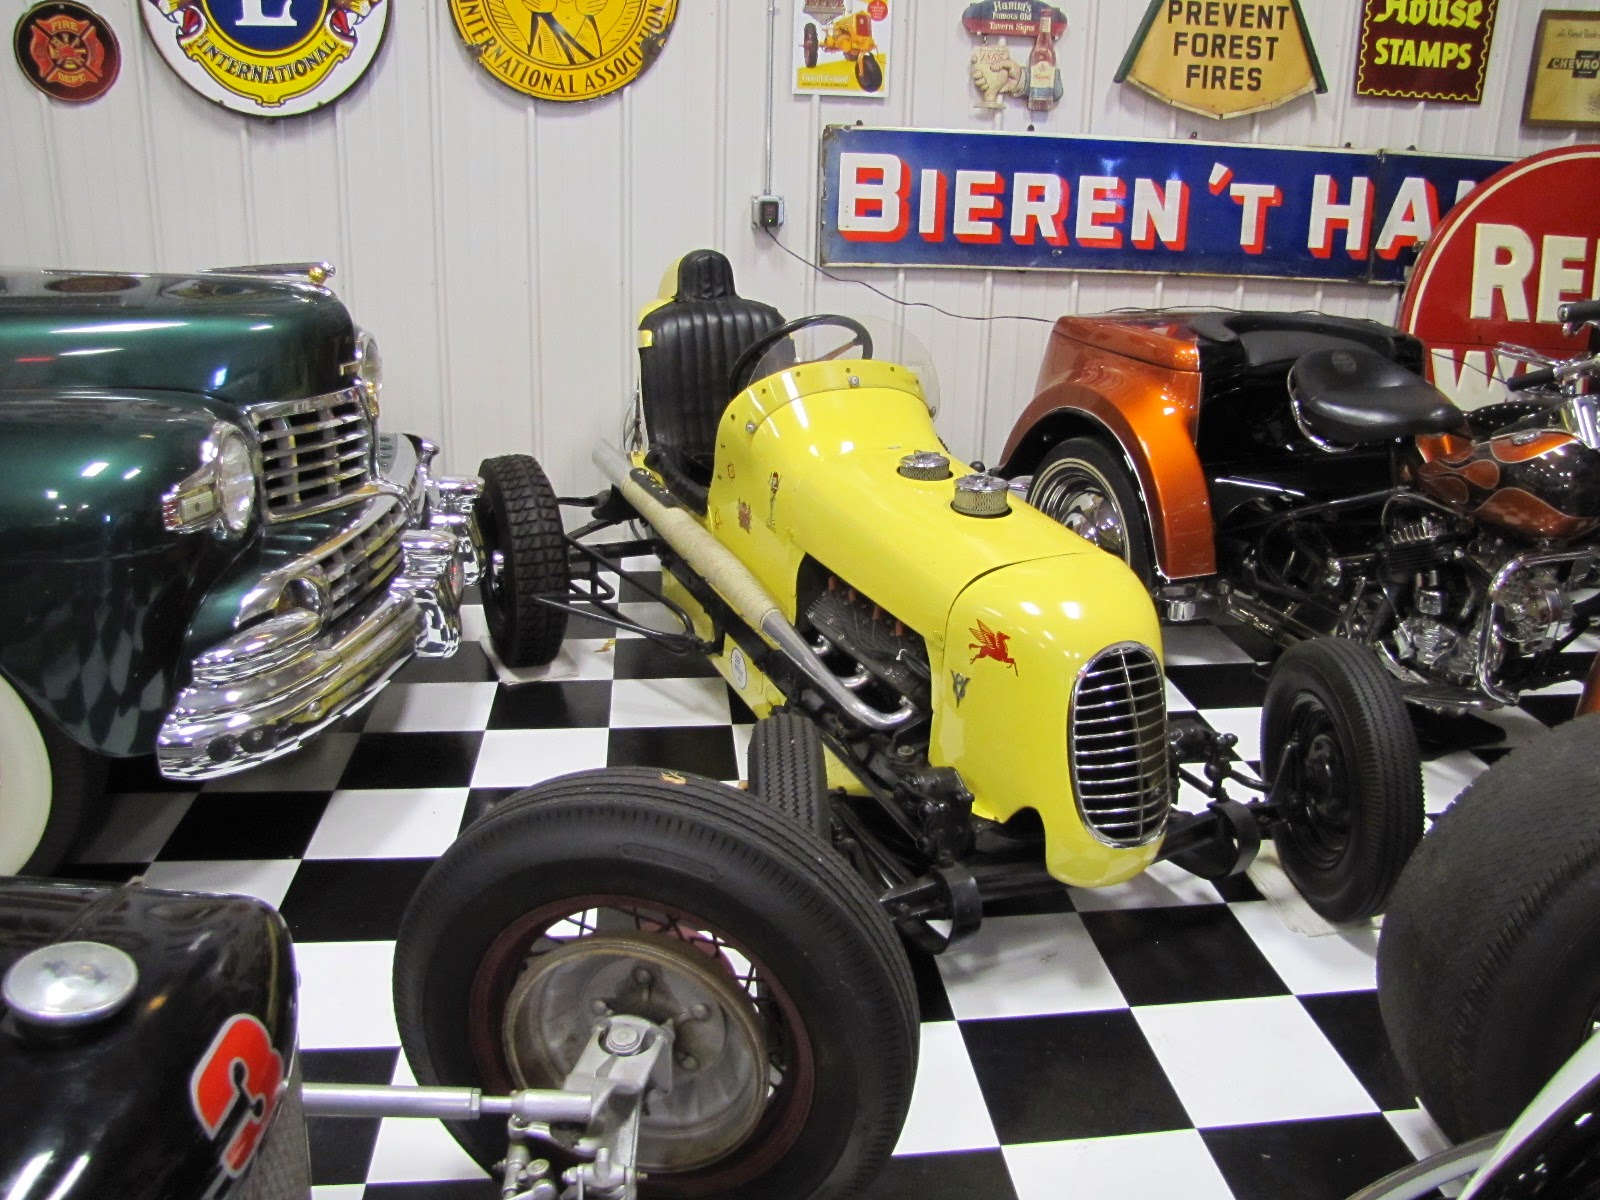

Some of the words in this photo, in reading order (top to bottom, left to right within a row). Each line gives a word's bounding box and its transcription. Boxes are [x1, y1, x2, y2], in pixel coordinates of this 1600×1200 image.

[993, 1, 1032, 13] Hamm's
[1167, 0, 1290, 30] PREVENT
[51, 20, 79, 31] FIRE
[989, 22, 1014, 31] Tavern
[1015, 23, 1036, 34] Signs
[196, 35, 338, 84] INTERNATIONAL
[585, 4, 667, 91] ASSOCITION
[1173, 31, 1279, 61] FOREST
[1374, 37, 1473, 70] STAMPS
[1185, 64, 1263, 92] FIRES
[837, 152, 1191, 252] BIEREN
[1208, 161, 1283, 256] 'T
[1306, 173, 1477, 261] HA
